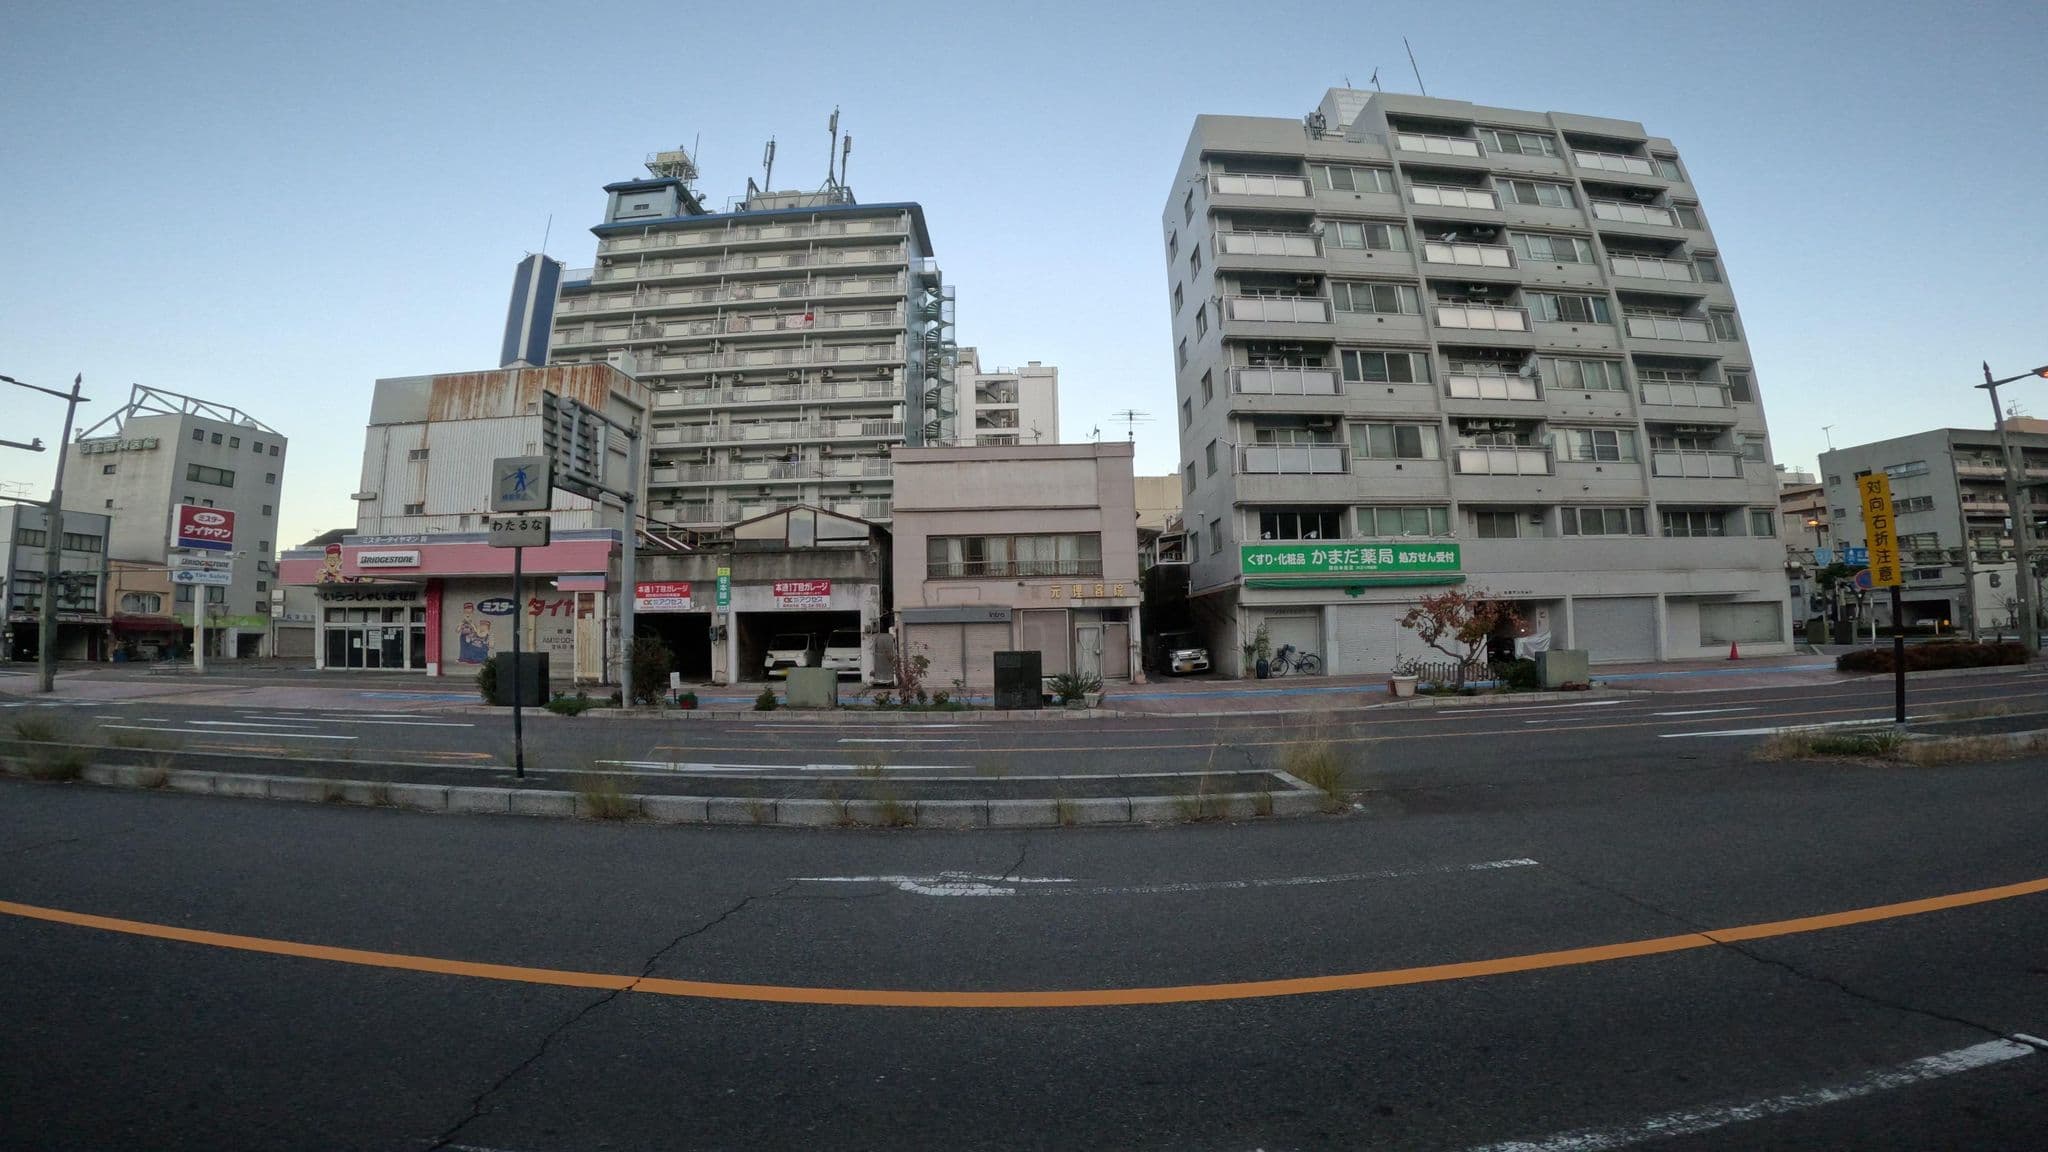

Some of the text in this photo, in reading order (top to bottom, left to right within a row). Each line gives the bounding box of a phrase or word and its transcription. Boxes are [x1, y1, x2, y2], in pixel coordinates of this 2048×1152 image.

[184, 525, 231, 537] タイヤマン
[493, 519, 543, 532] わたるな
[1867, 480, 1893, 582] 対向右折注意
[360, 555, 414, 564] BRIDGESTONE
[1247, 547, 1455, 566] くすり・化粧品 かまだ薬局 処方せん受付
[481, 601, 514, 612] ミスター
